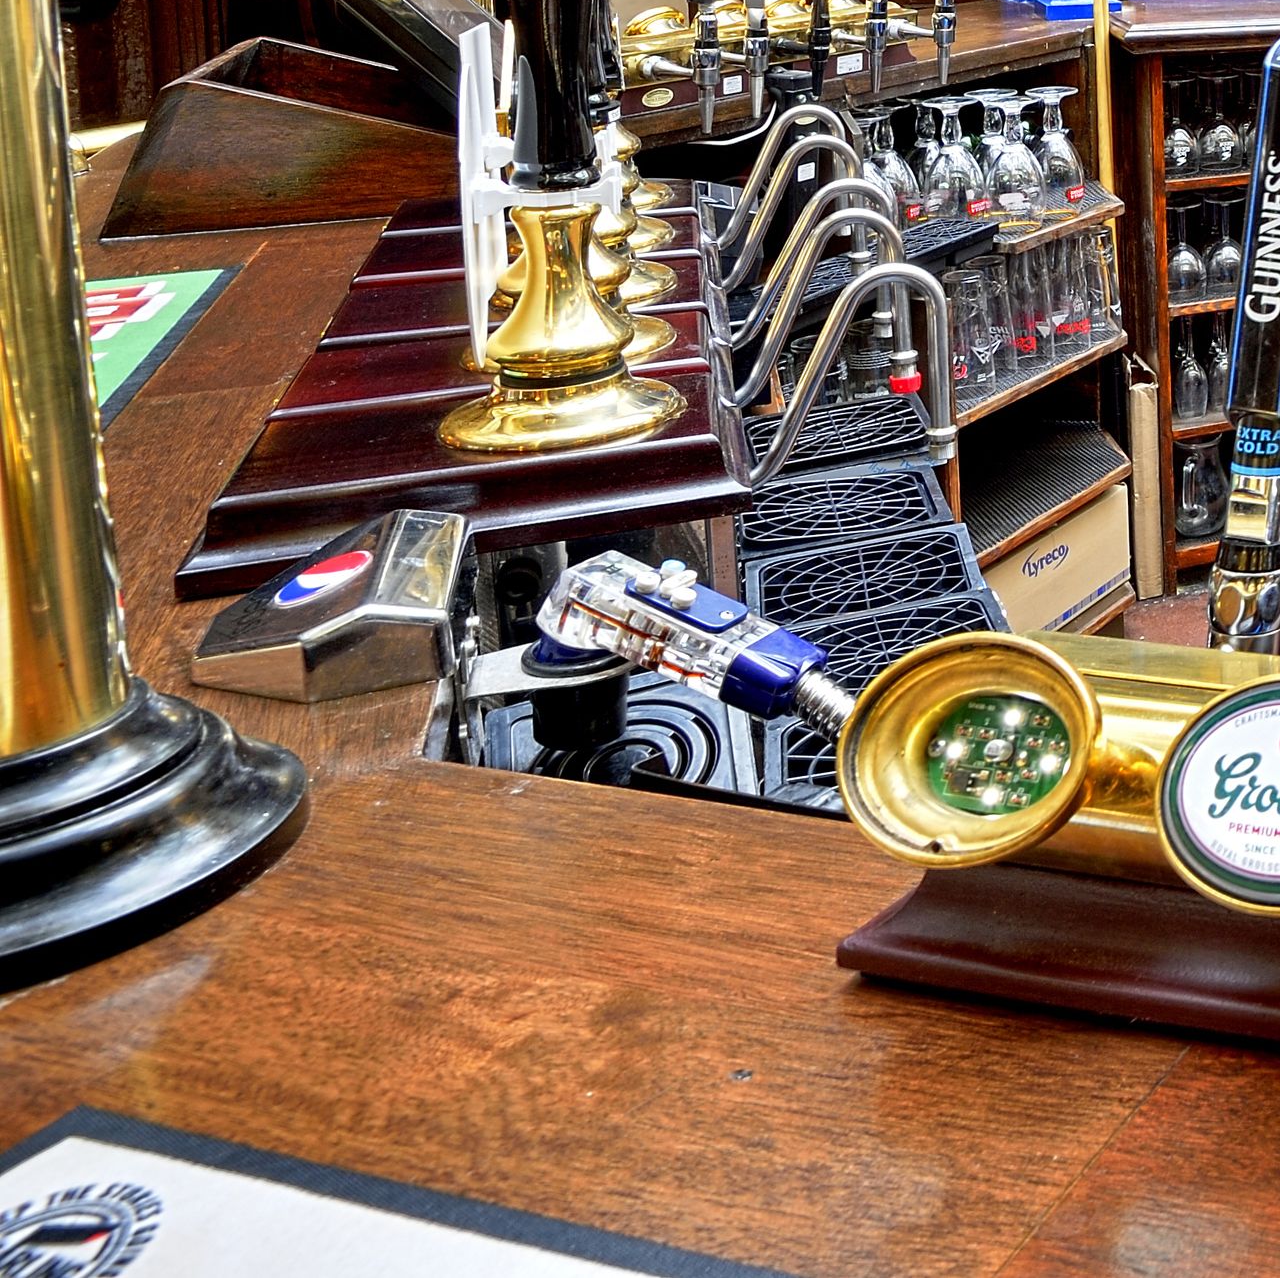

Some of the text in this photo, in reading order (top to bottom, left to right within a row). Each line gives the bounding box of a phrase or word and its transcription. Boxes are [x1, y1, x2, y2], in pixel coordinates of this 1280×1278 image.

[1236, 440, 1280, 457] COLD
[1023, 544, 1069, 578] Lyreco
[1210, 839, 1237, 862] ROYAL
[1244, 843, 1275, 856] SINCE
